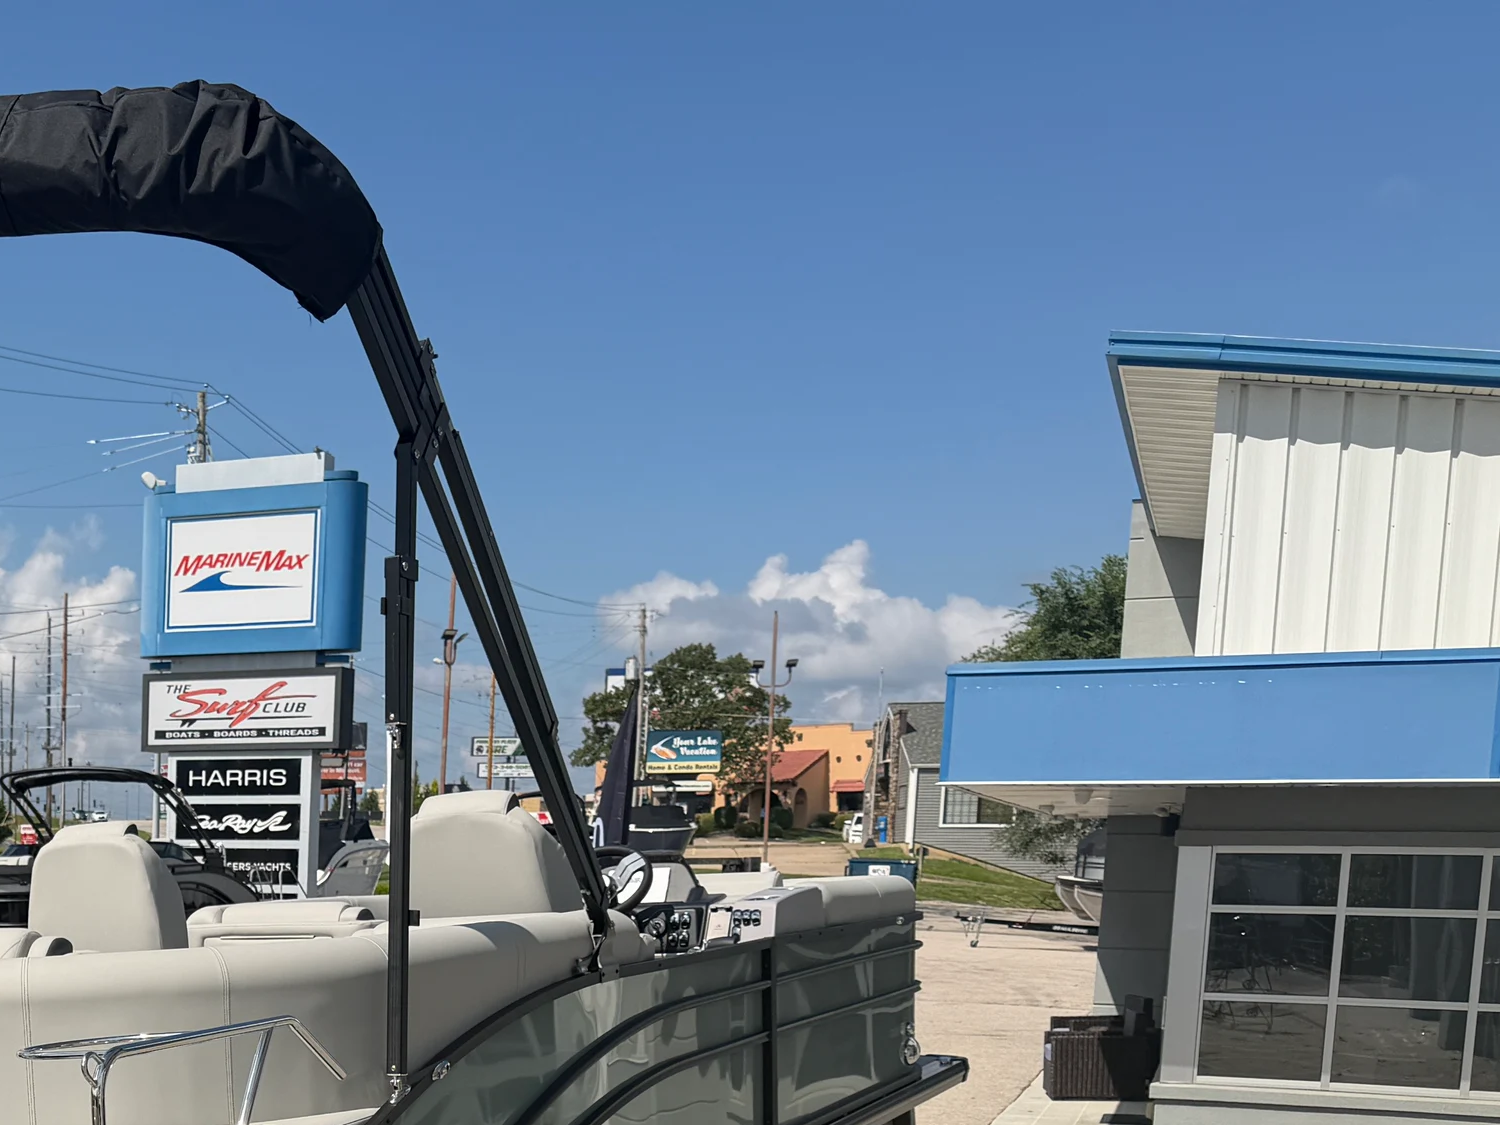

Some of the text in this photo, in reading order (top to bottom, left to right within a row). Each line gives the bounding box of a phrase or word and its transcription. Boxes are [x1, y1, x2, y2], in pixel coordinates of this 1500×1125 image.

[174, 549, 310, 577] MARINEMAX
[166, 684, 192, 694] THE
[169, 681, 317, 728] Surf
[262, 702, 307, 714] CLUB
[165, 728, 320, 739] BOATS BOARDS THREADS
[697, 736, 718, 746] Lake
[188, 768, 288, 788] HARRIS
[217, 813, 258, 834] Ray
